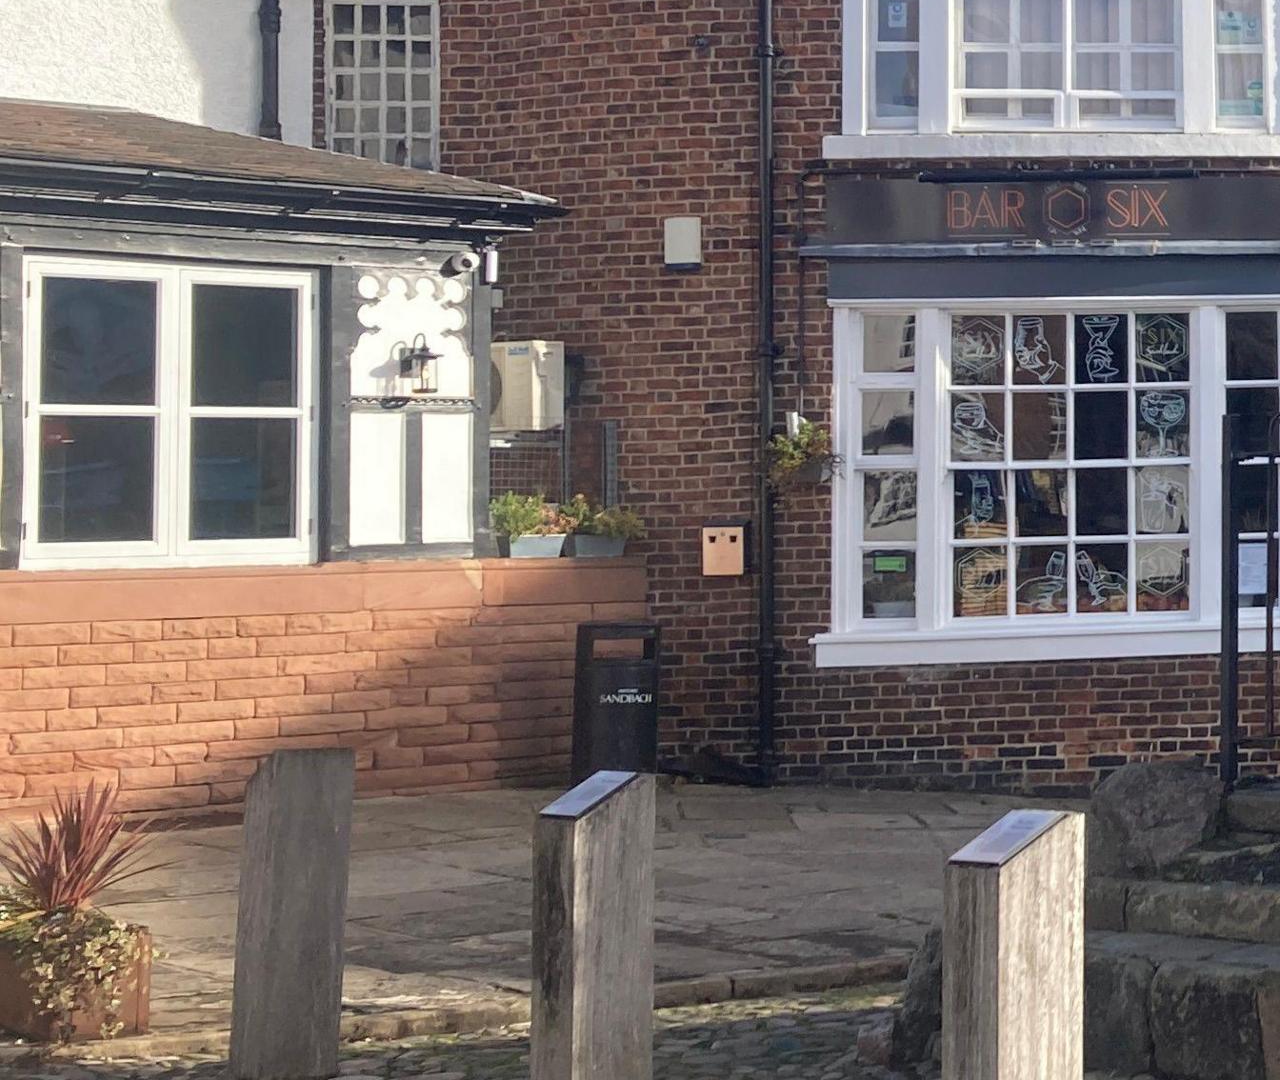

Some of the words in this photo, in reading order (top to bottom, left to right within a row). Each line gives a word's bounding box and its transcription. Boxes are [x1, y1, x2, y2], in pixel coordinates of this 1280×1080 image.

[947, 190, 1026, 229] BAR
[1106, 188, 1169, 228] SIX
[1147, 327, 1179, 344] SIX
[599, 693, 653, 704] SANDBACH
